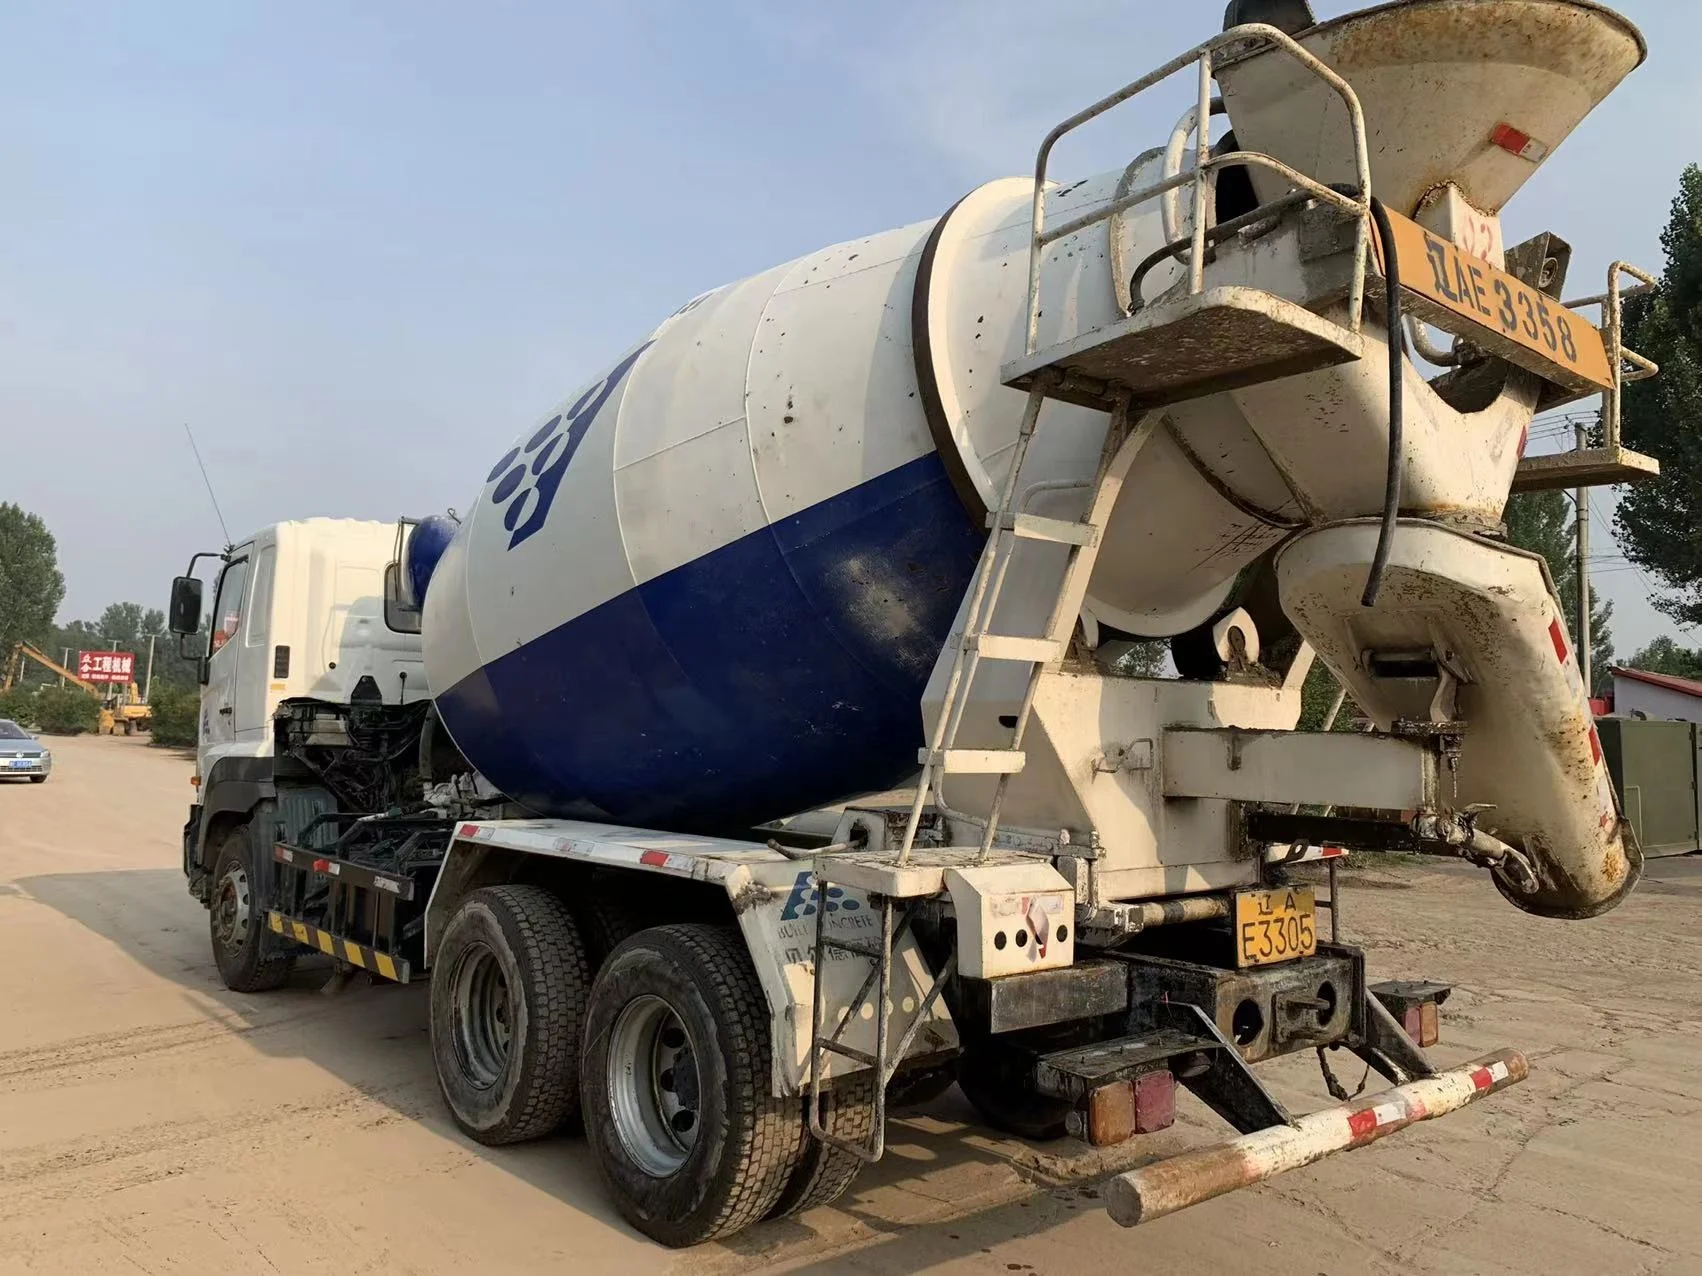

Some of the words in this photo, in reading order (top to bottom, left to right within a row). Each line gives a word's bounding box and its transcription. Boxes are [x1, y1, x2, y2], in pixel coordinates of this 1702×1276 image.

[92, 656, 132, 674] 工程机械
[1242, 913, 1313, 960] E3305
